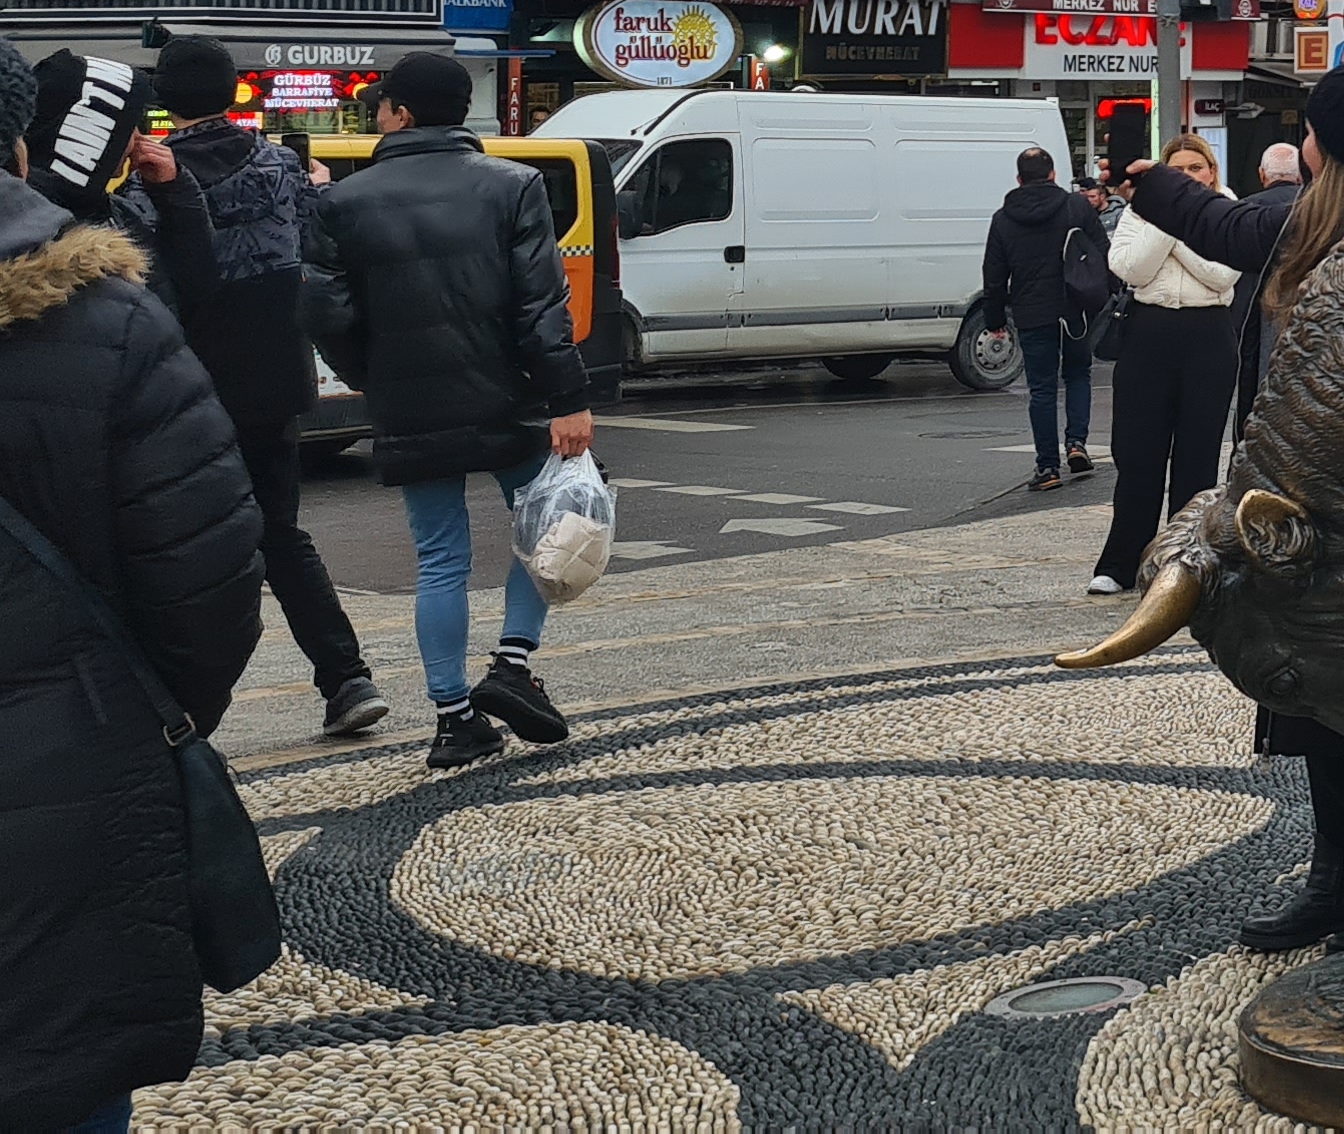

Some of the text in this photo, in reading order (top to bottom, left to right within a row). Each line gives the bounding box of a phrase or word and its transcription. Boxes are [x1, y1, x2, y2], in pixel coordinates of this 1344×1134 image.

[614, 7, 673, 33] faruk
[1035, 13, 1186, 46] ECZAN
[288, 45, 375, 66] GURBUZ
[615, 34, 712, 68] güllüoğlu
[1063, 55, 1159, 73] MERKEZ NUR
[274, 73, 332, 87] GÜRBÜZ
[272, 86, 333, 98] SARRAFİYE
[264, 97, 339, 109] MÜCEVHERAT
